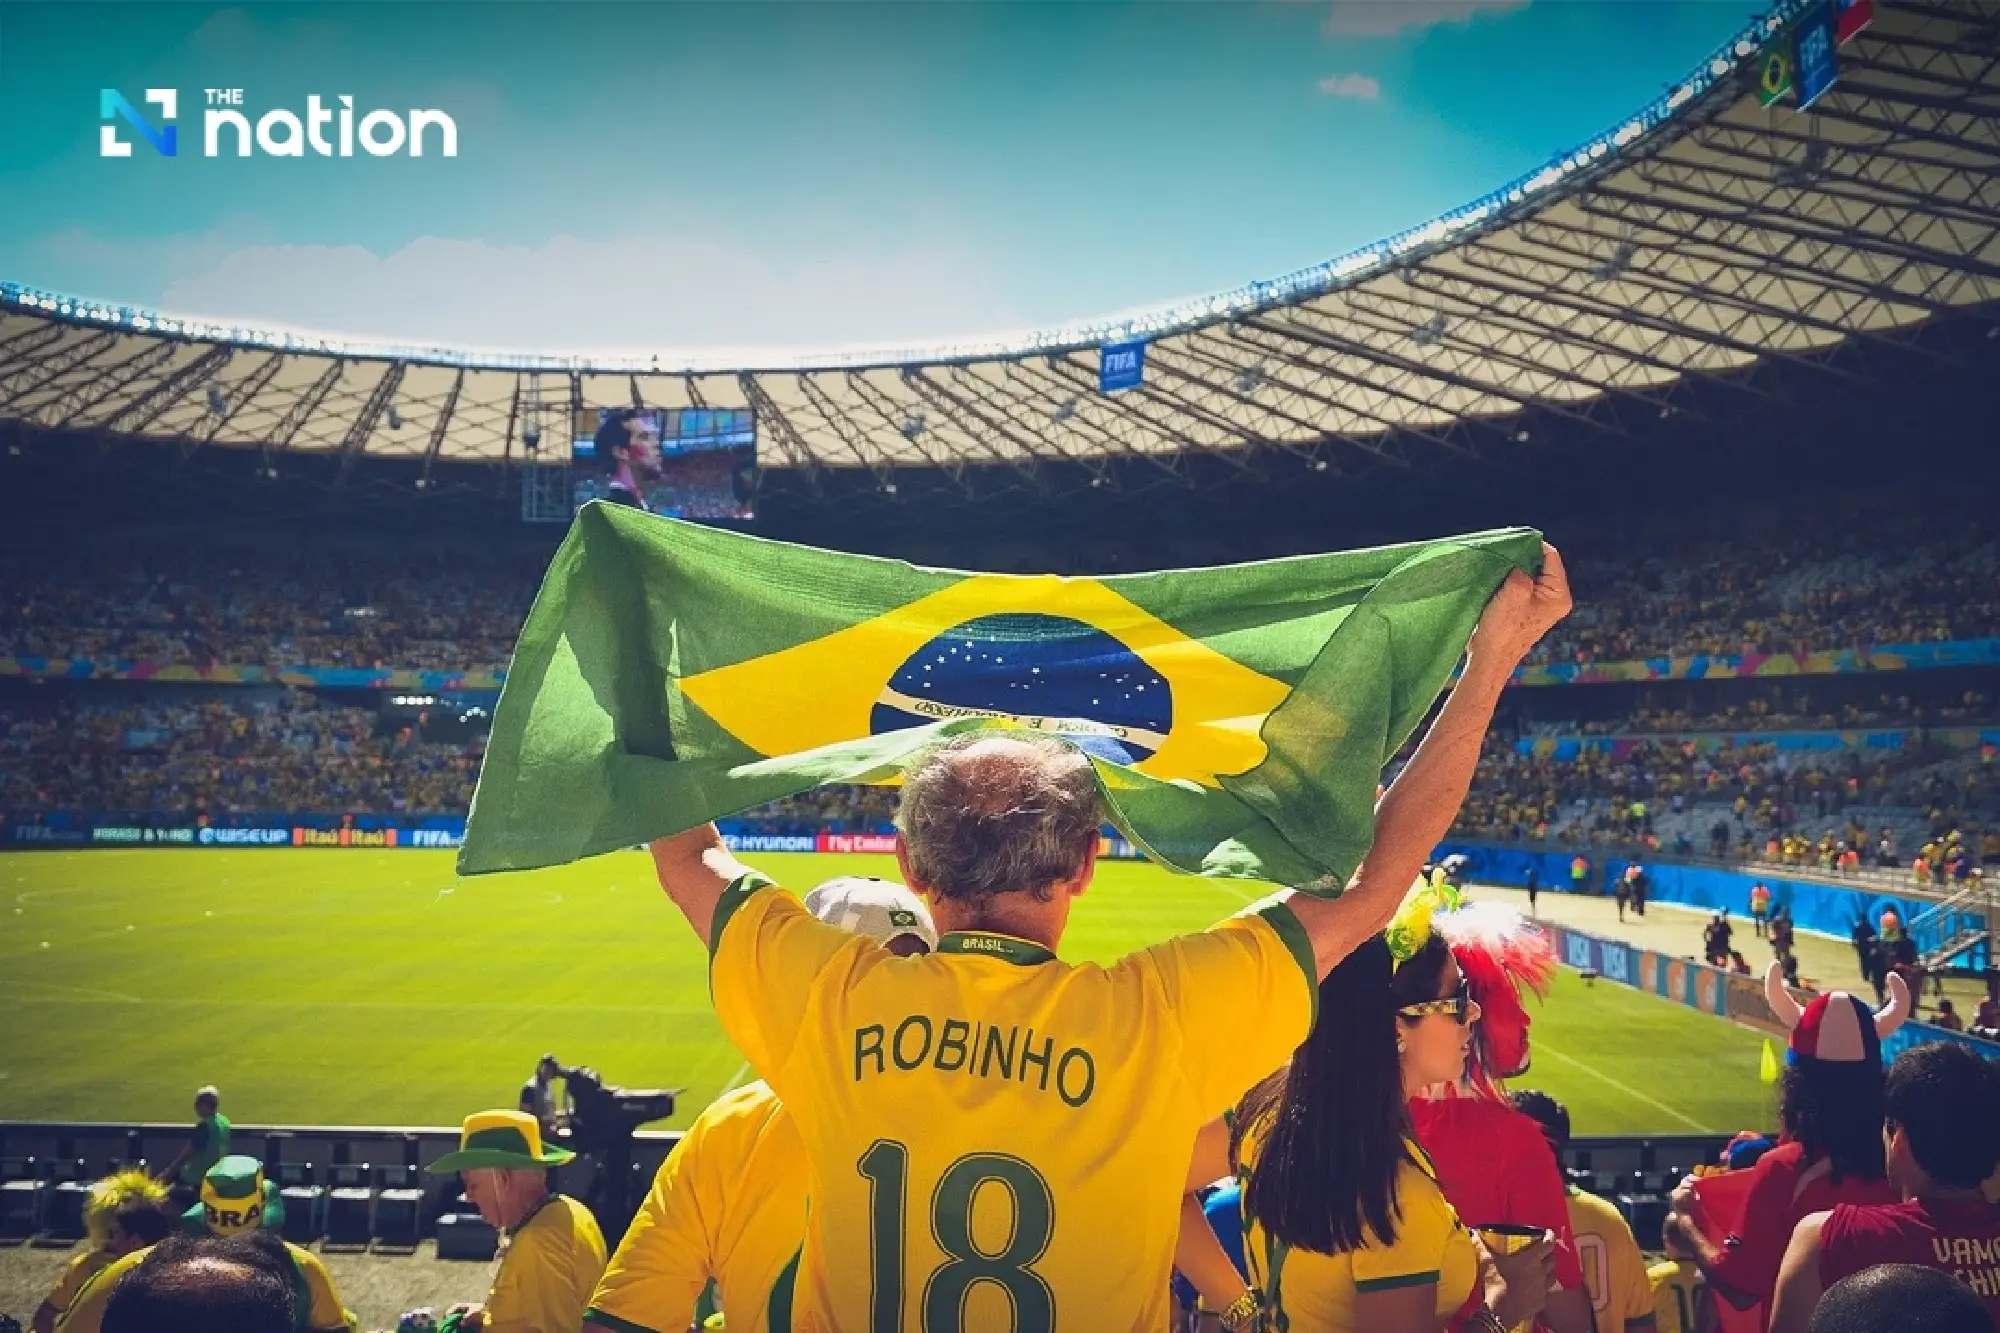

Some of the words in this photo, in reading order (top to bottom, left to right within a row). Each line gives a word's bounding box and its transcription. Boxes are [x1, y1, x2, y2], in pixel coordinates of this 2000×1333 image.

[1104, 351, 1136, 373] FIFA
[962, 938, 1005, 952] BRASIL
[854, 1014, 1096, 1108] ROBINHO
[857, 1138, 1056, 1333] 18
